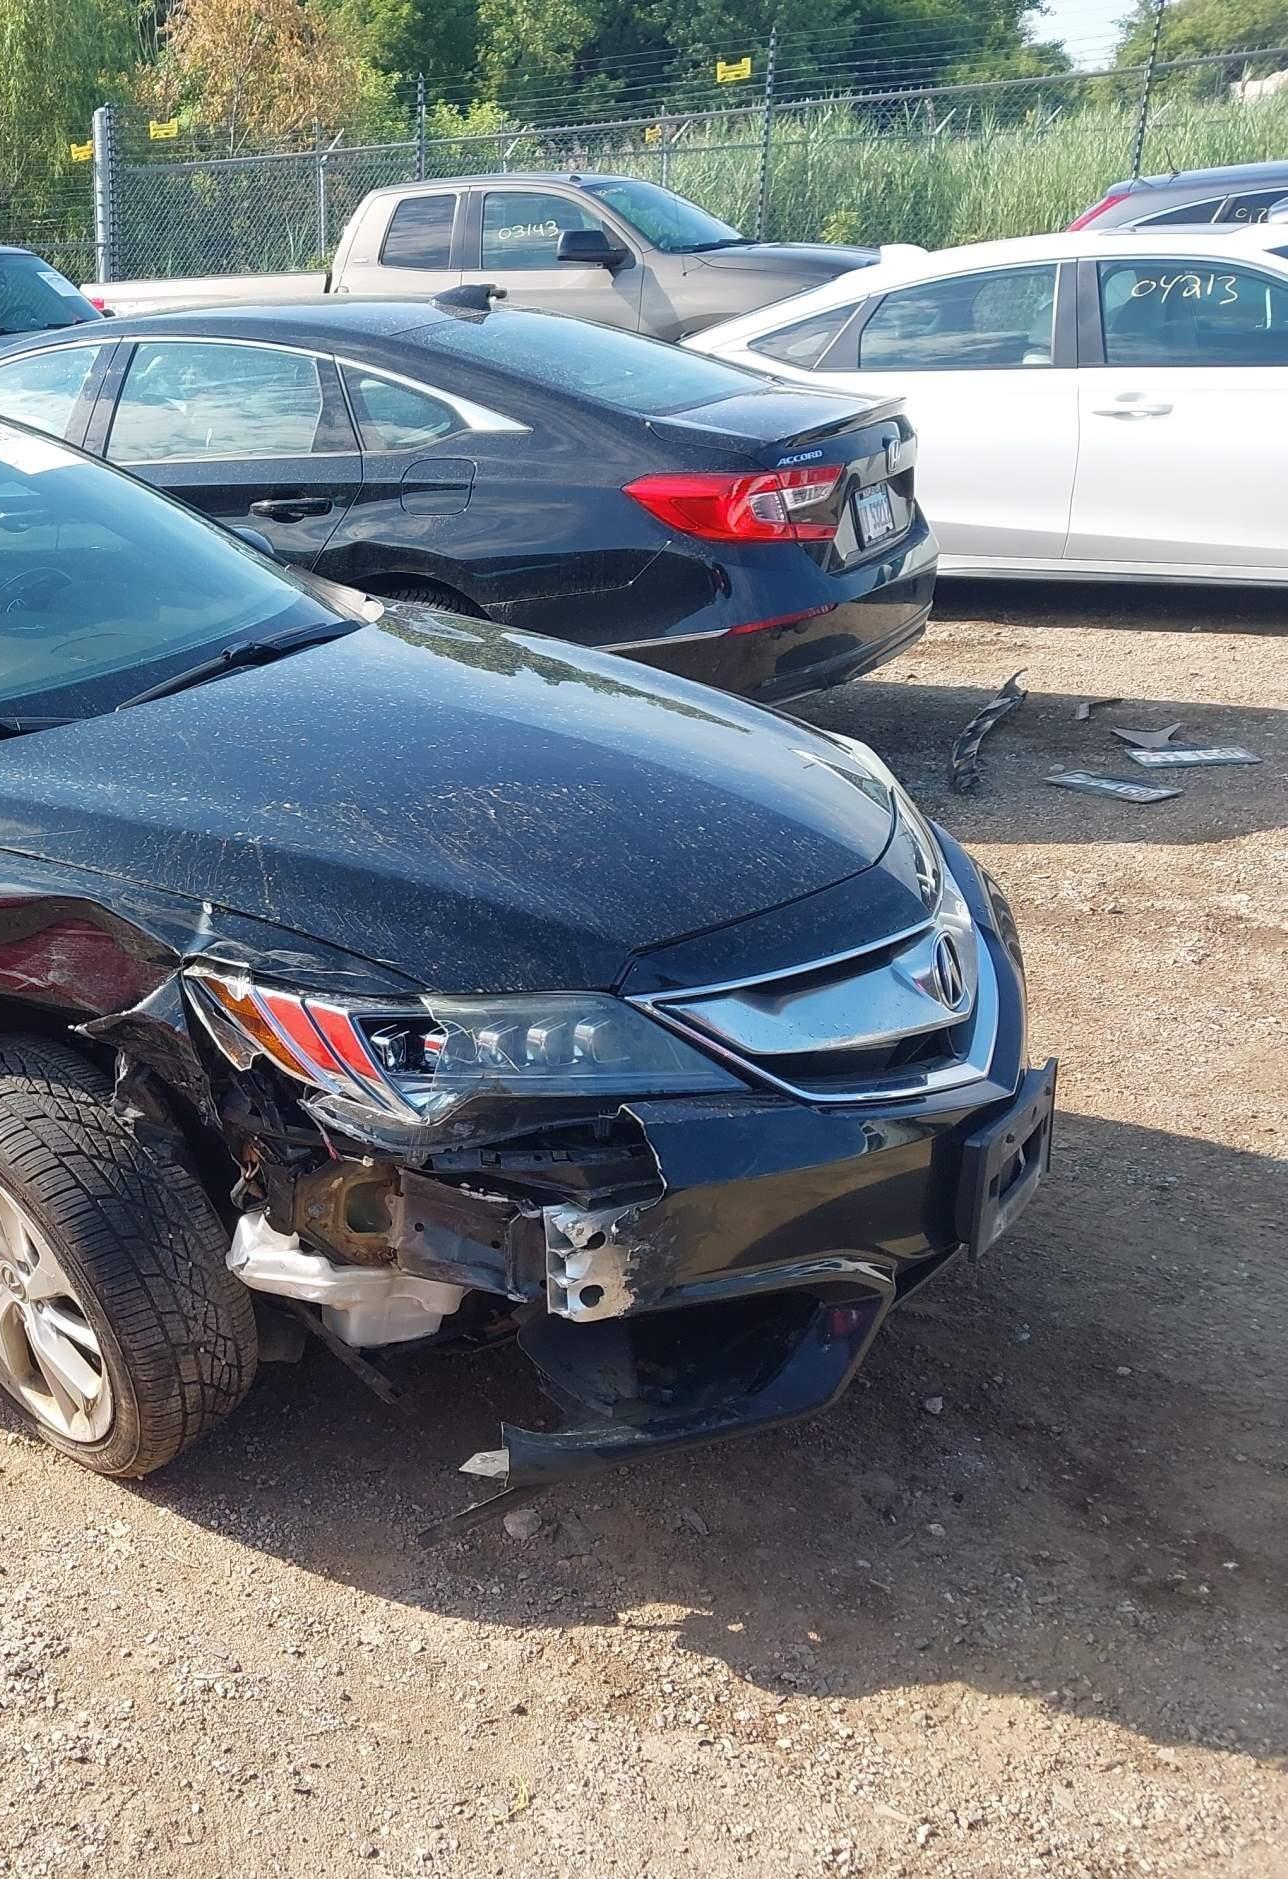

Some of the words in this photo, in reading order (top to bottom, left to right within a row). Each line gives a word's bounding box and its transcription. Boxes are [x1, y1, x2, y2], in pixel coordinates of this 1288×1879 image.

[498, 220, 559, 240] 03143
[1131, 273, 1239, 305] 04213
[777, 450, 823, 467] ACCORD
